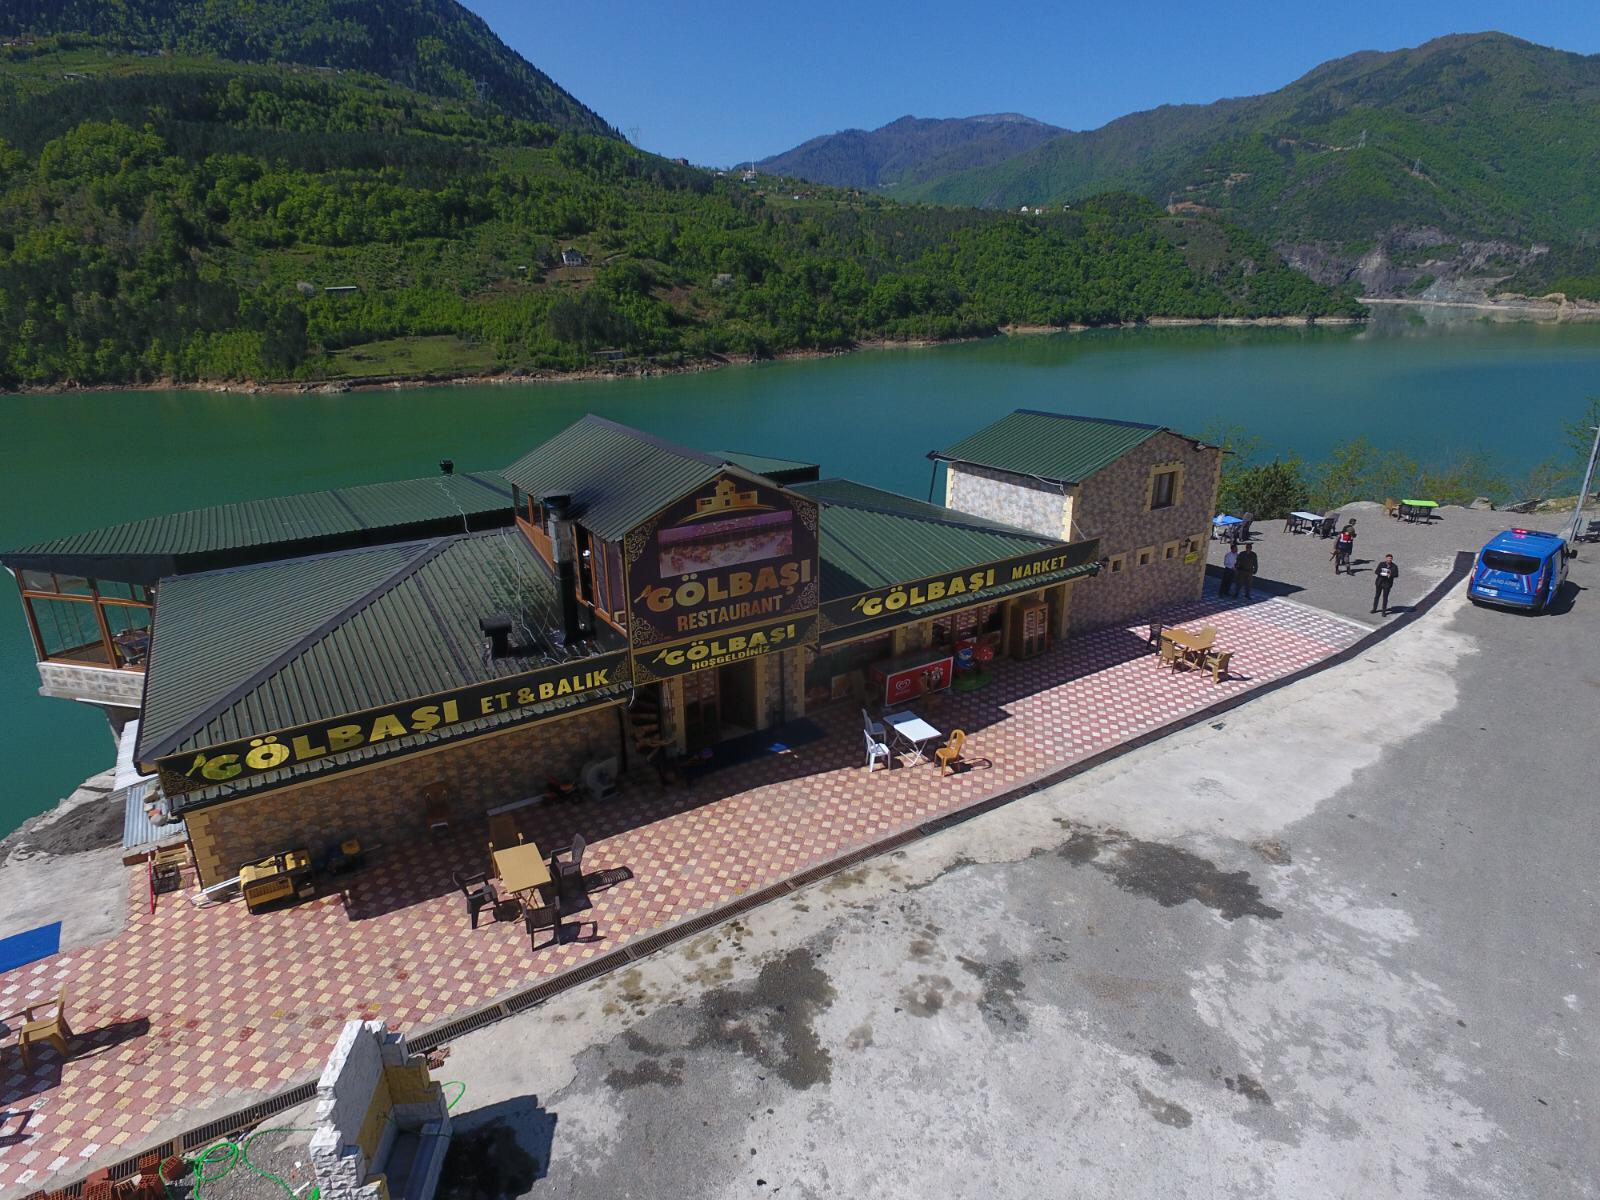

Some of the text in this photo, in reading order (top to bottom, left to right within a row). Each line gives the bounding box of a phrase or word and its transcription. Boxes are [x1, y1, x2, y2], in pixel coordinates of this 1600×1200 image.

[646, 559, 812, 612] GÖLBAŞI
[862, 555, 1068, 616] GÖLBAŞI MARKET
[677, 595, 784, 632] RESTAURANT
[664, 623, 796, 666] GÖLBAŞI
[201, 699, 460, 781] GÖLBAŞI
[538, 668, 609, 700] BALIK
